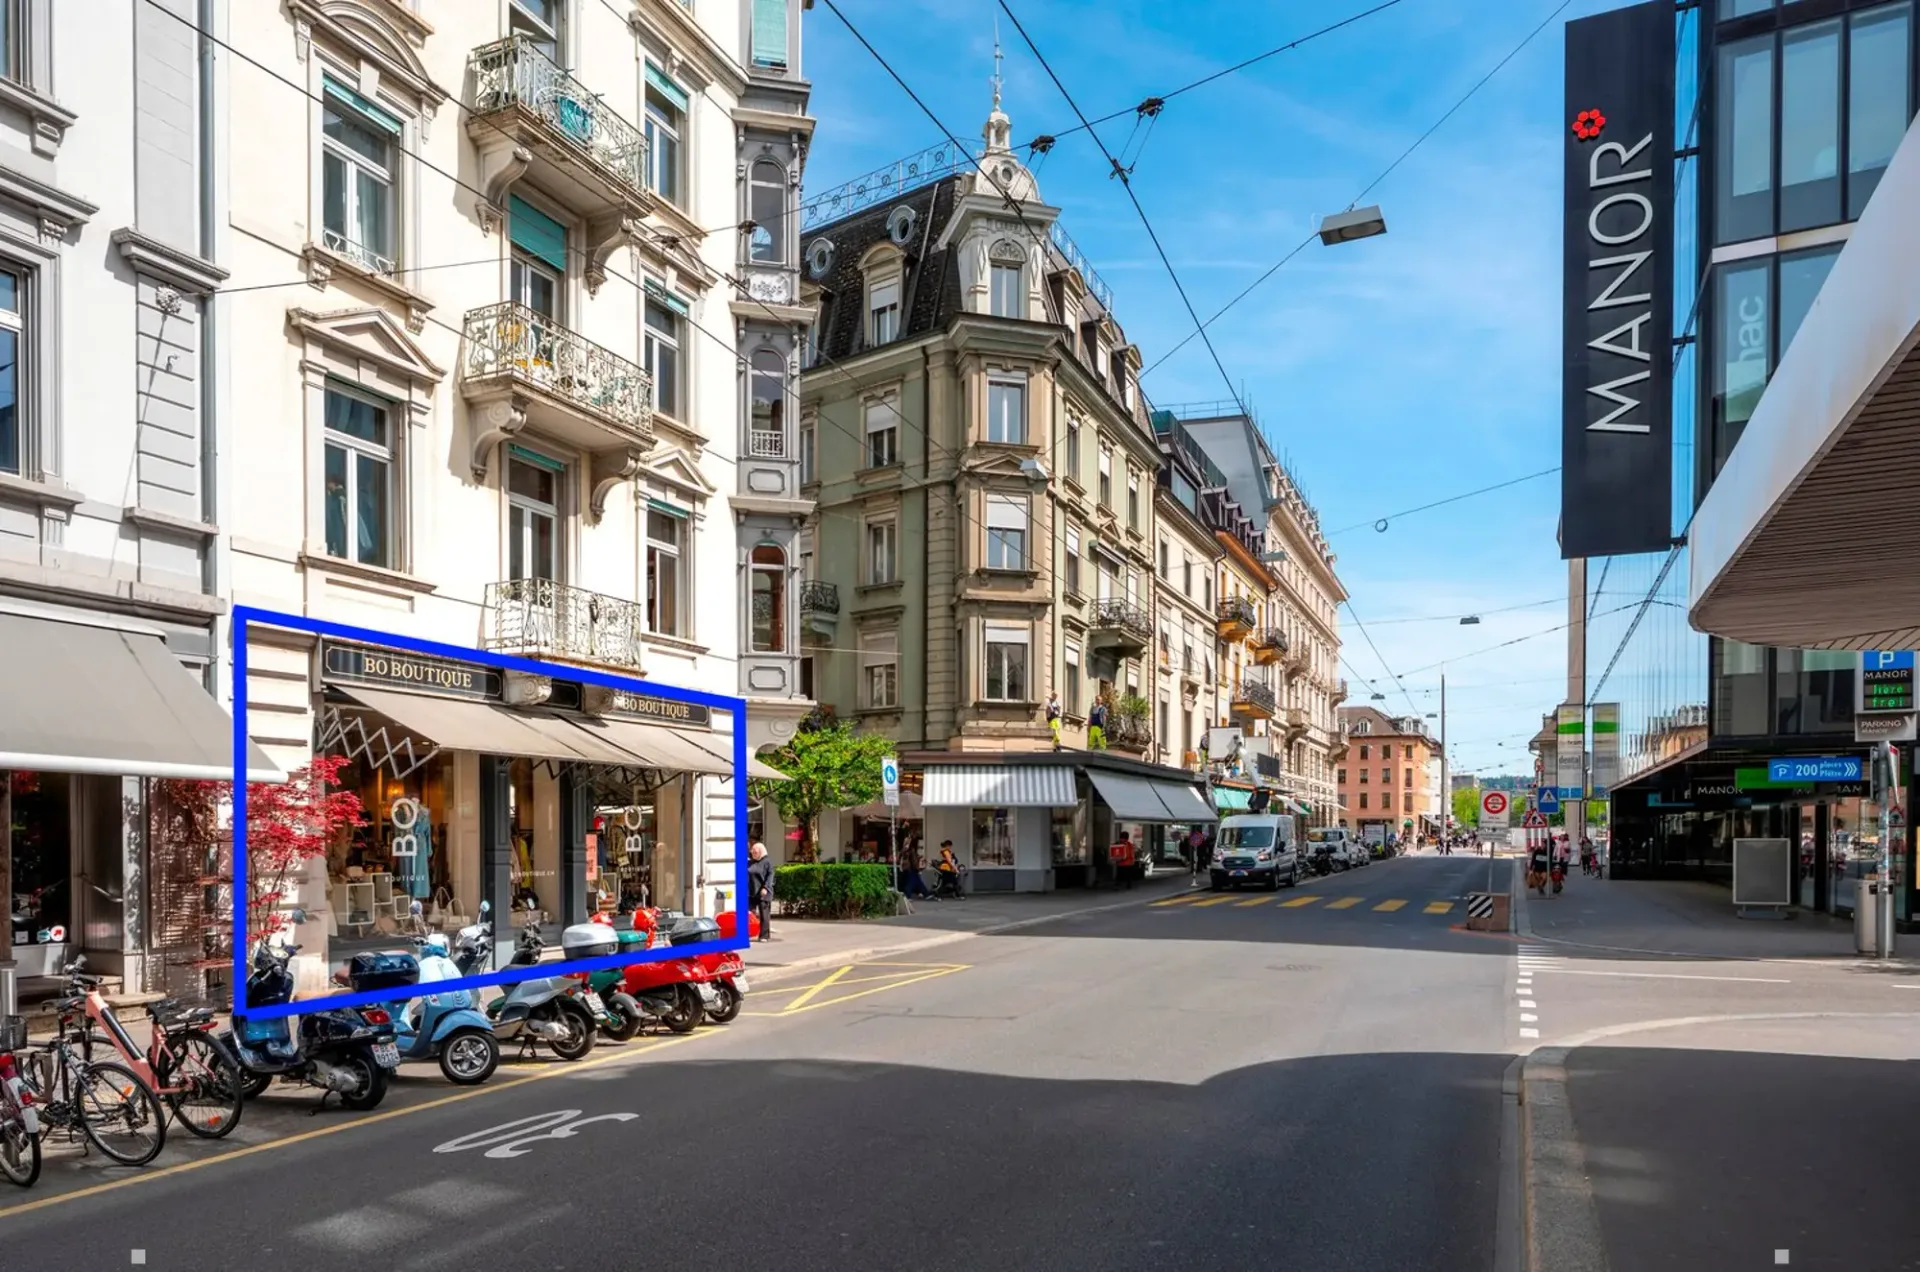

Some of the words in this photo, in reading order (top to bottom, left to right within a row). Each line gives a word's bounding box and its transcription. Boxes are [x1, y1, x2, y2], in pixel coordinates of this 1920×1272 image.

[1585, 132, 1653, 435] MANOR
[364, 656, 388, 675] BO
[391, 660, 473, 689] BOUTIQUE
[1864, 669, 1908, 679] MANOR
[622, 698, 637, 711] BO
[638, 699, 691, 719] BOUTIQUE
[1872, 697, 1903, 707] frei
[1861, 720, 1901, 729] PARKING
[1796, 764, 1818, 776] 200
[392, 797, 417, 857] BO
[625, 806, 642, 852] BO
